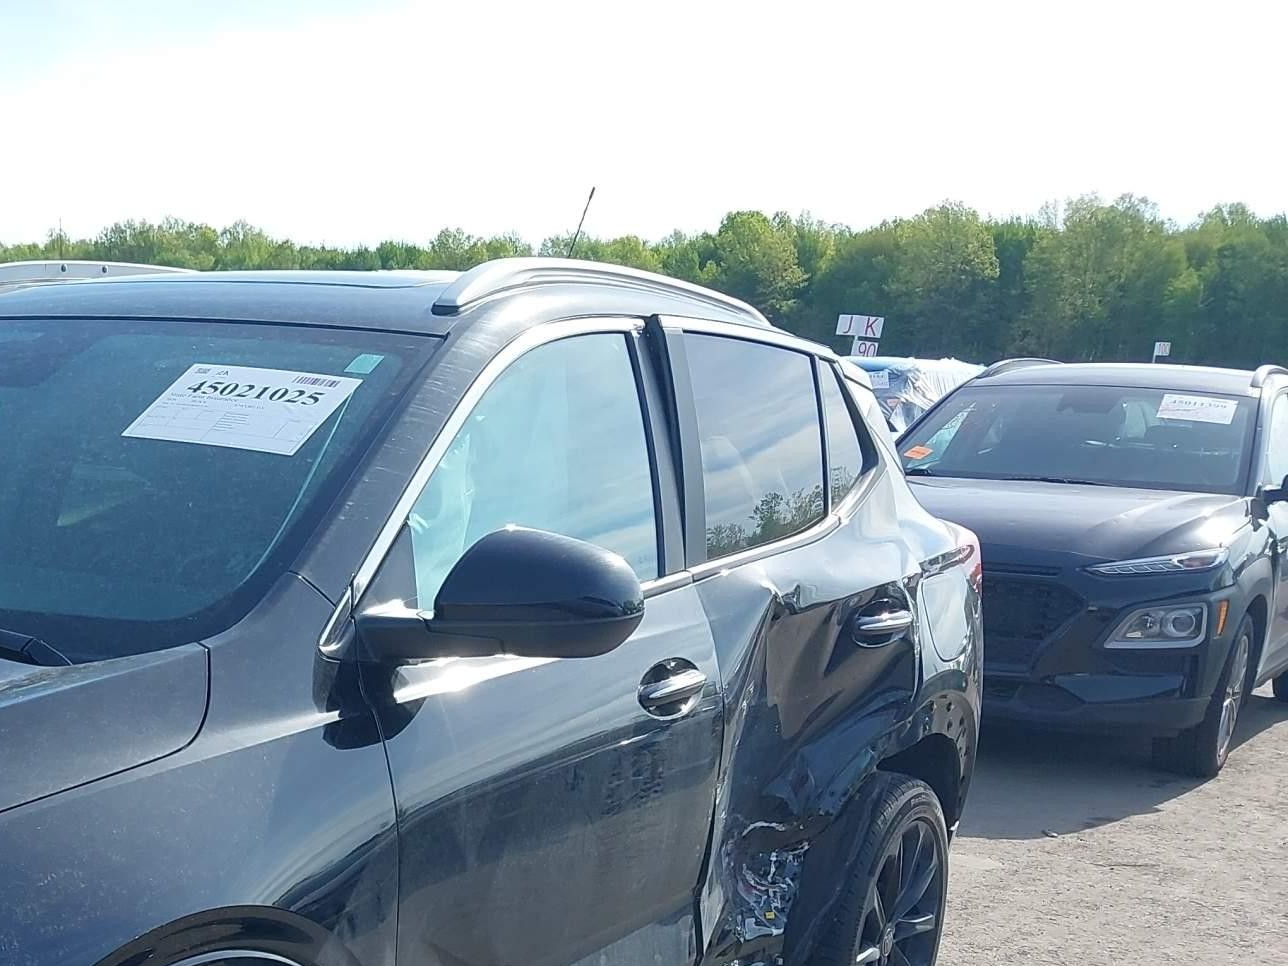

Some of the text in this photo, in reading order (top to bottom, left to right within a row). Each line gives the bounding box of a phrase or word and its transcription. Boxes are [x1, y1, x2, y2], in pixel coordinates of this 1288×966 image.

[843, 316, 879, 337] J K
[858, 342, 877, 358] 90
[187, 380, 326, 406] 45021025
